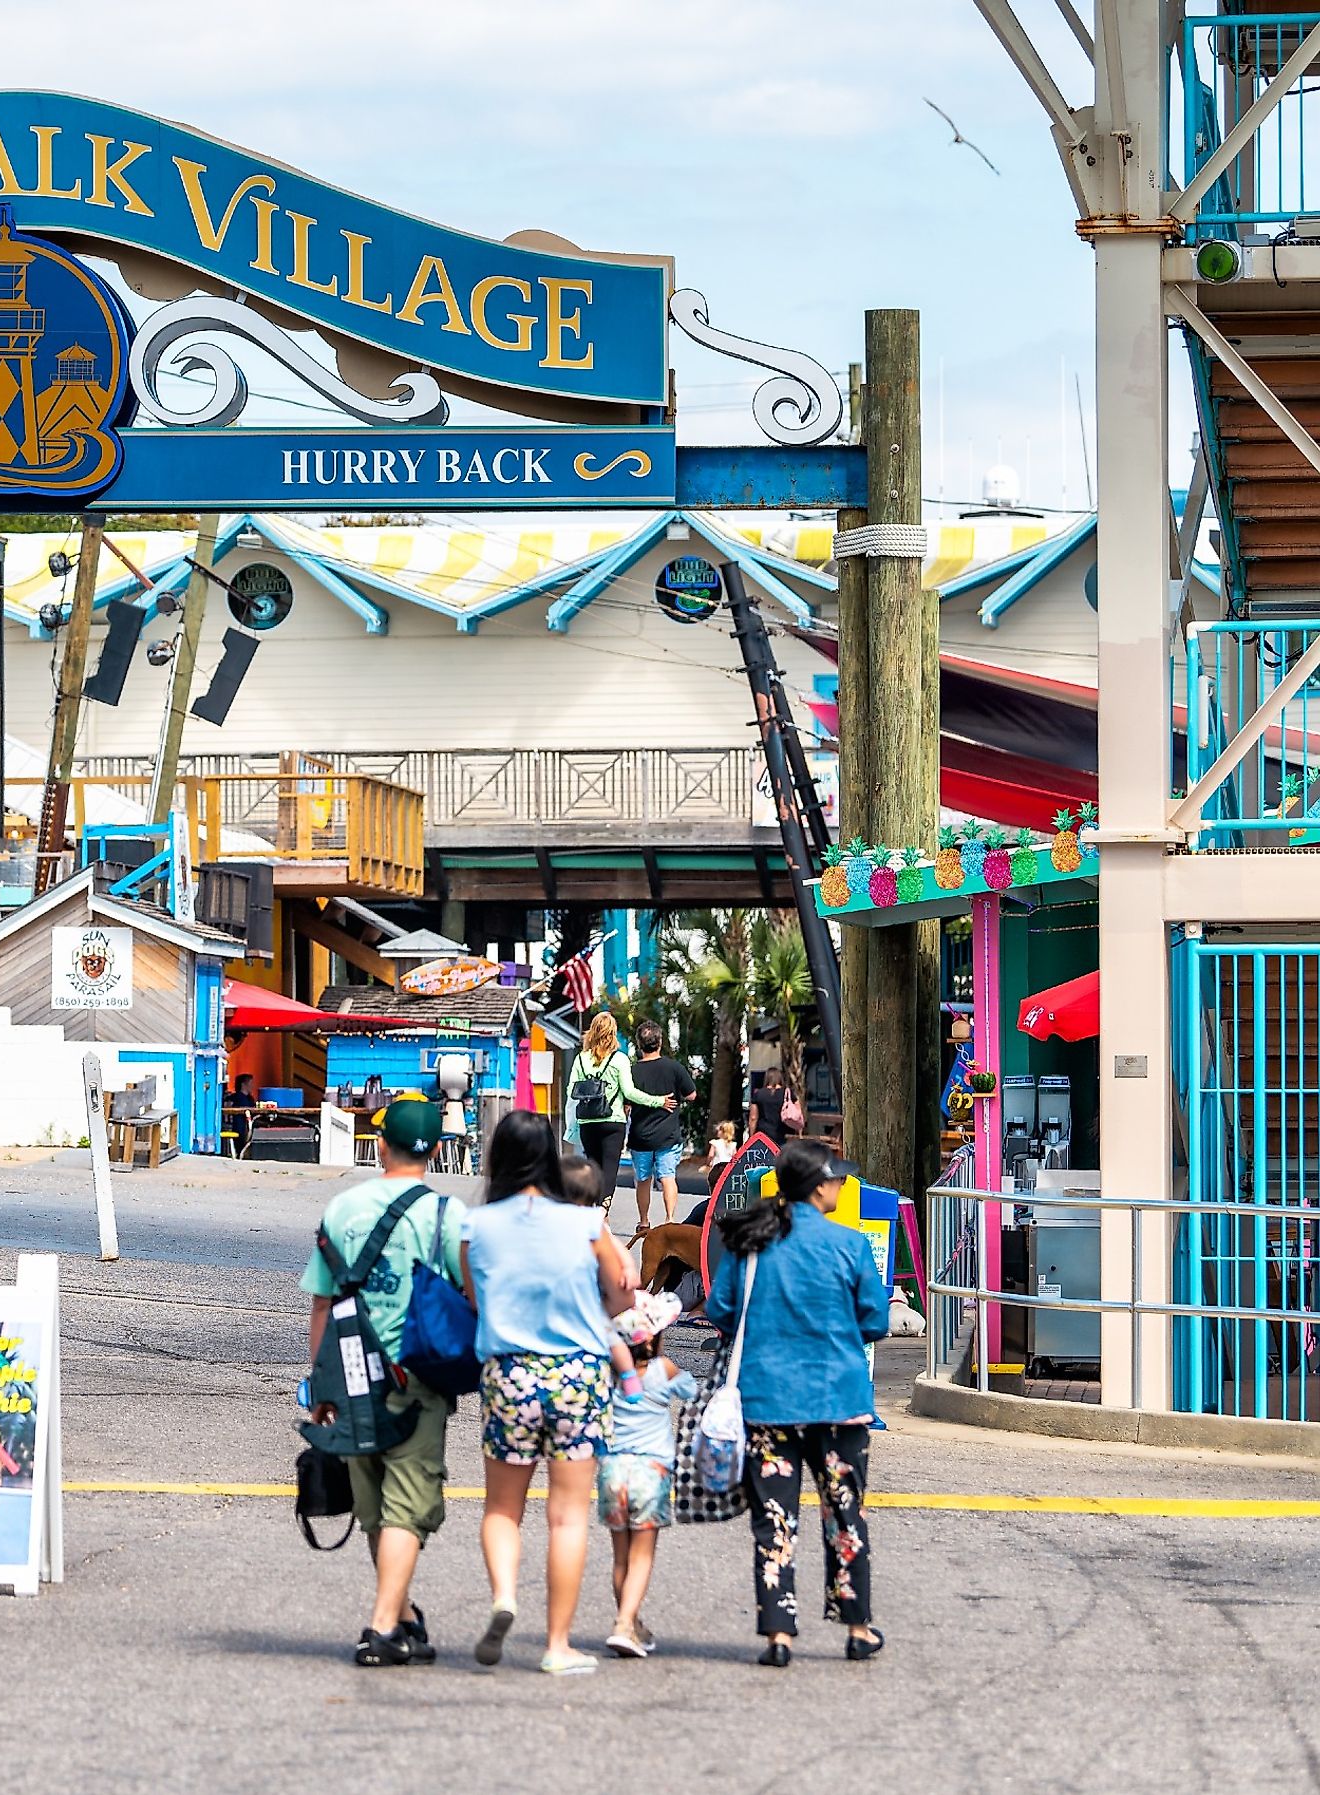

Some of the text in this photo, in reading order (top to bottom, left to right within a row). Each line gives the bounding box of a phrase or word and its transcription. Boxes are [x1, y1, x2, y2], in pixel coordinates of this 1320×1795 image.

[172, 155, 595, 371] VILLAGE
[281, 447, 552, 485] HURRY BACK
[82, 930, 111, 947] SUN
[66, 973, 122, 996] PARASAIL
[55, 997, 129, 1008] (850) 259-1898
[747, 1149, 769, 1163] TRY
